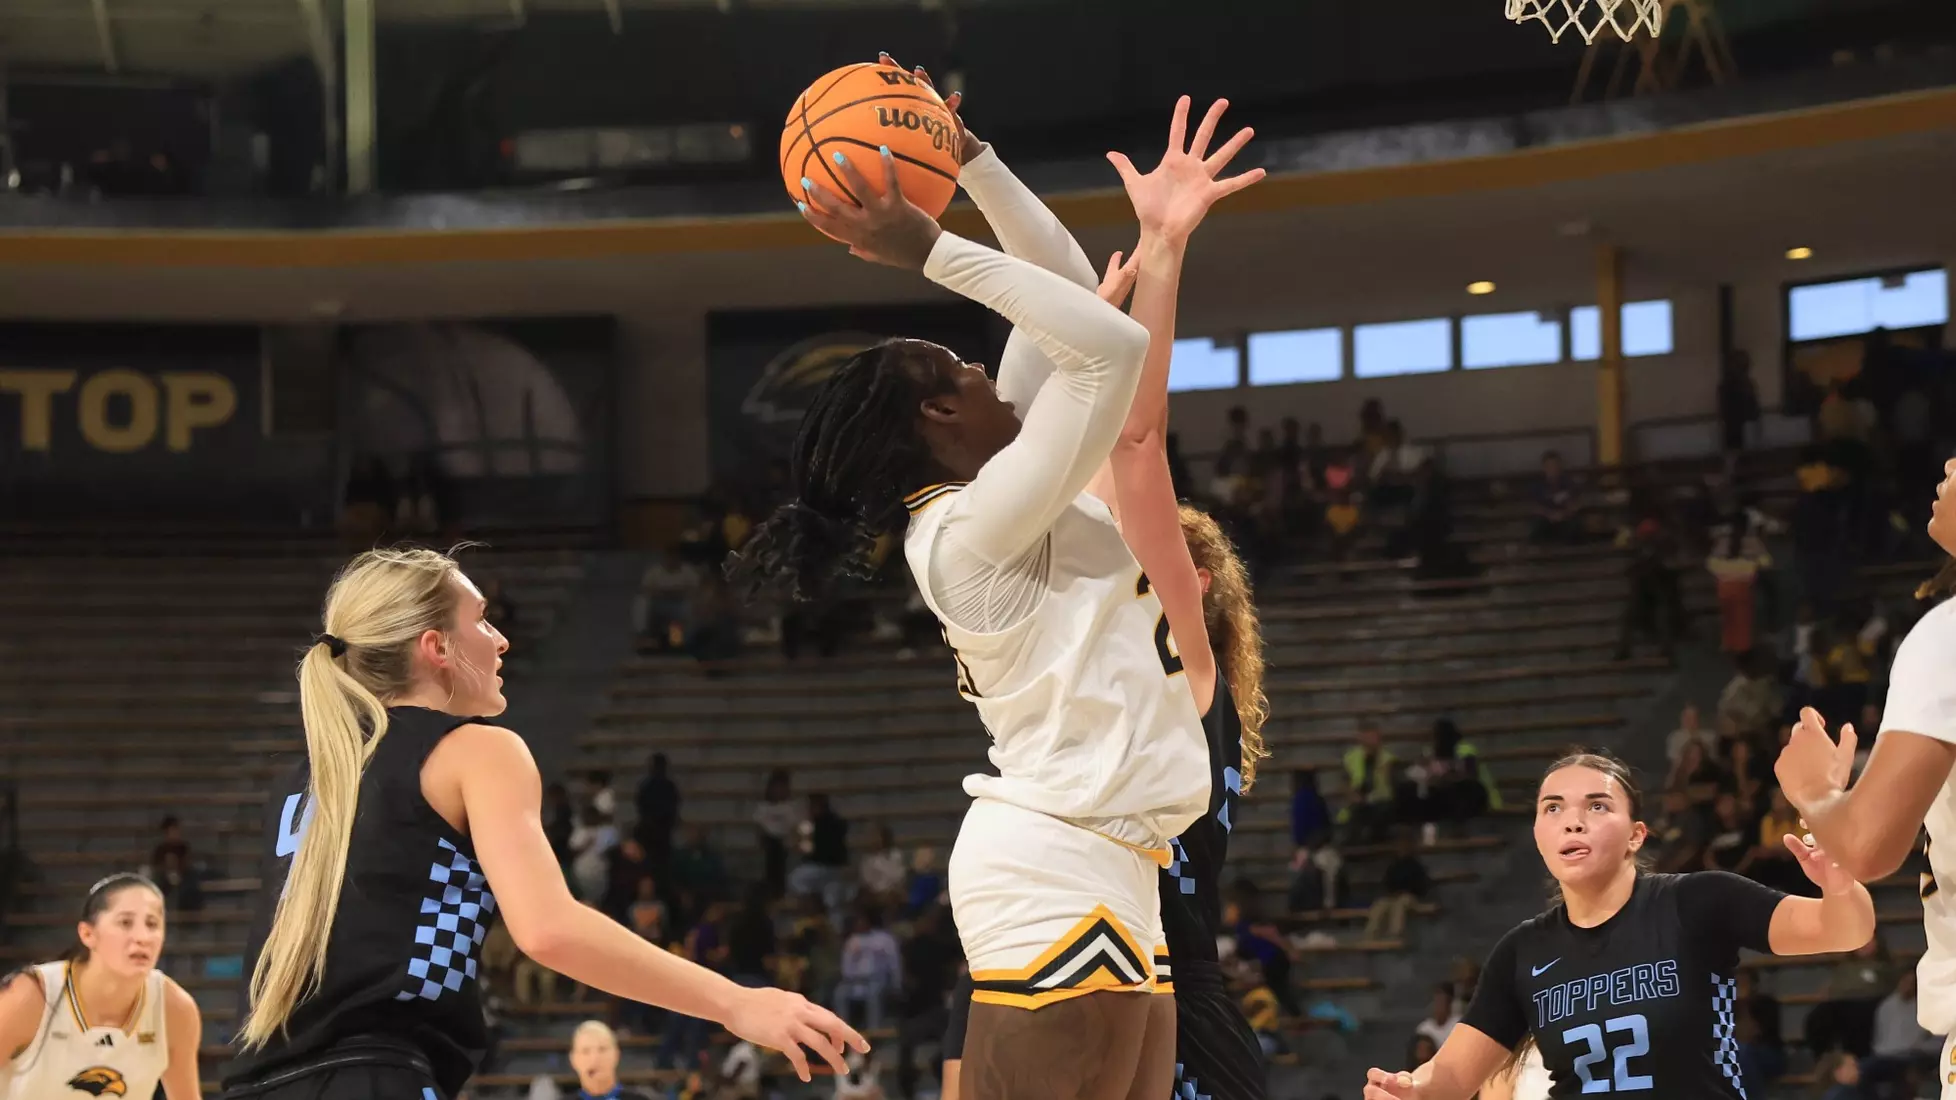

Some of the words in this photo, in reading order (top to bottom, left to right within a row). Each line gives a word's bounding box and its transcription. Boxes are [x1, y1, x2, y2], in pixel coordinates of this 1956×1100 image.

[0, 368, 238, 450] TOP
[1533, 960, 1680, 1028] TOPPERS
[1562, 1014, 1654, 1094] 22
